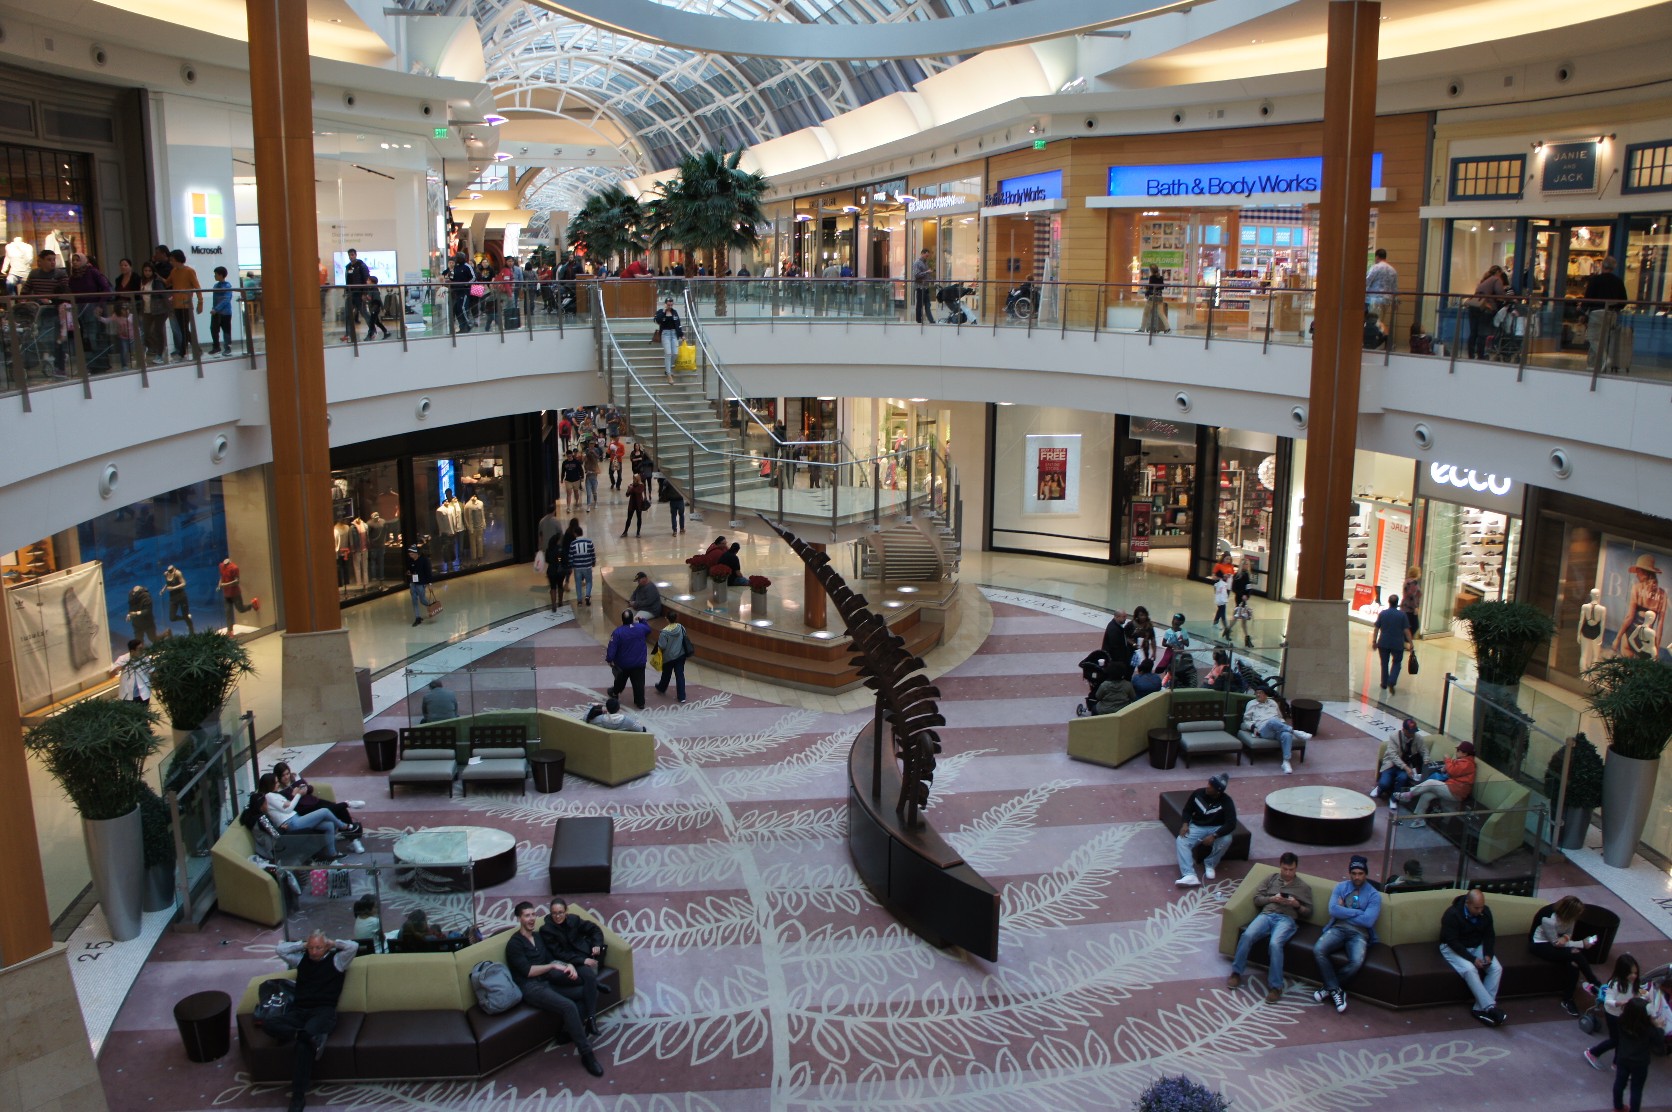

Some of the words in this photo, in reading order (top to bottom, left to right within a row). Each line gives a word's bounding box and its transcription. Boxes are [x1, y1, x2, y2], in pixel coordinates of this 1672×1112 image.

[1553, 150, 1588, 161] JANIE
[1552, 173, 1584, 182] JACK
[1146, 178, 1189, 196] Bath
[1191, 177, 1205, 195] &
[1208, 176, 1256, 198] Body
[1258, 174, 1317, 193] Works
[1005, 189, 1024, 206] Body
[1022, 186, 1047, 202] Works
[191, 245, 223, 255] Microsoft
[1040, 452, 1066, 461] FREE
[77, 940, 115, 962] 25
